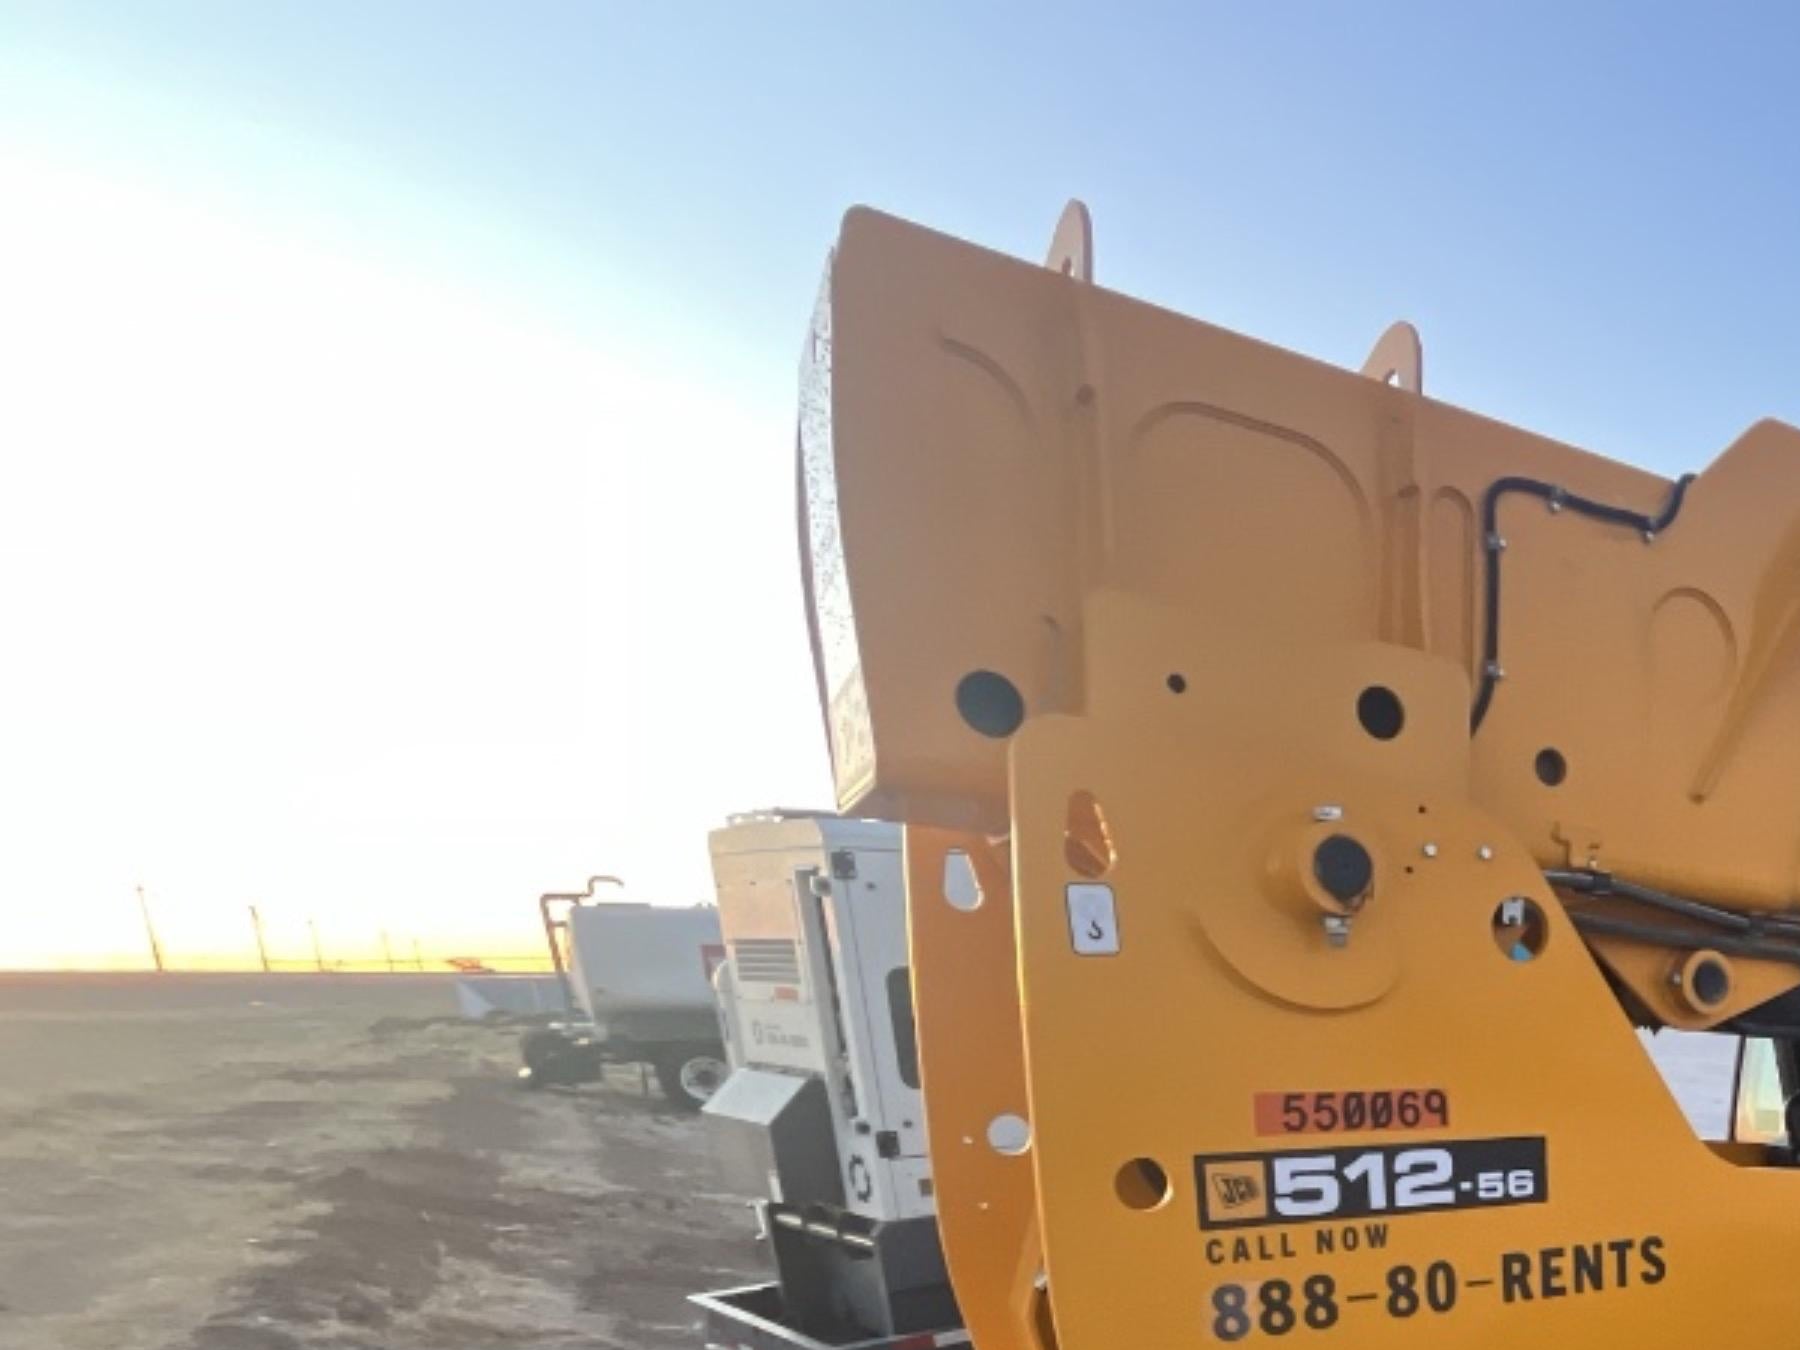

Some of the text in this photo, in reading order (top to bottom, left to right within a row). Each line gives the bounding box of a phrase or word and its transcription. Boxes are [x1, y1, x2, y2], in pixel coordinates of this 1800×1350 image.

[1282, 1088, 1450, 1132] 550069
[1205, 1223, 1390, 1264] CALL NOW
[1211, 1235, 1668, 1342] 888-80-RENTS
